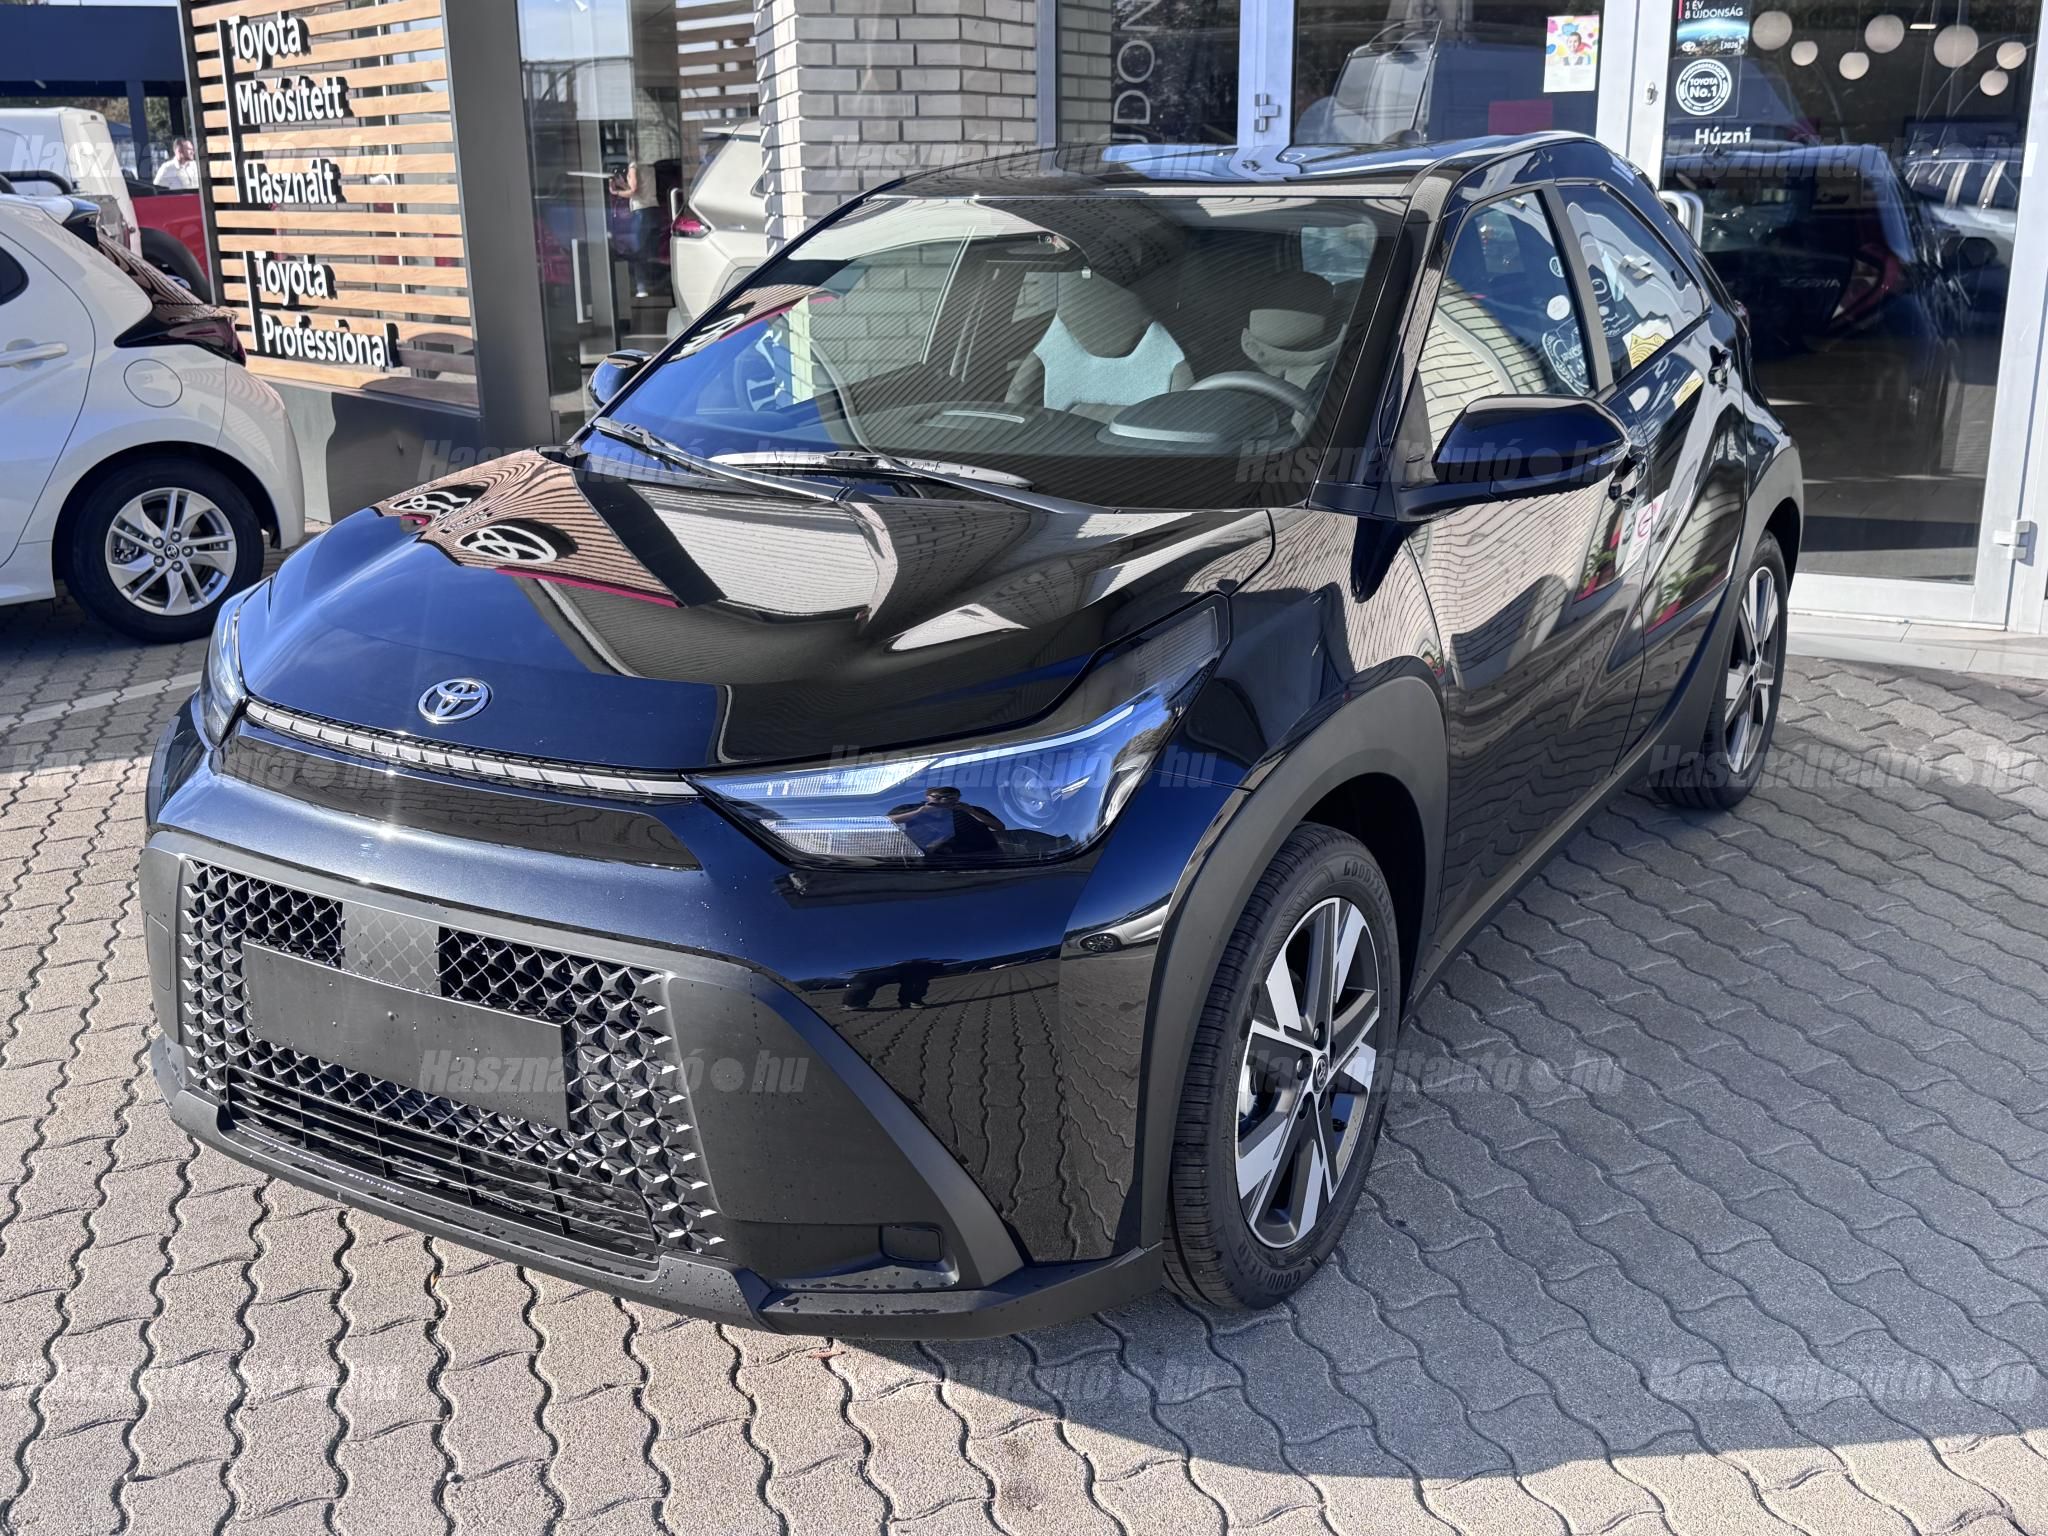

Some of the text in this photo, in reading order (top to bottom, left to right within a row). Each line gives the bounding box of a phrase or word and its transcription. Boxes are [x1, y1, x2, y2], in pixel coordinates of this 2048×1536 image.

[228, 11, 301, 71] Toyota
[235, 75, 344, 126] Minősített
[1689, 77, 1718, 86] TOYOTA
[1689, 85, 1718, 98] No.1
[1694, 126, 1751, 145] Húzni
[244, 157, 337, 204] Használt
[254, 250, 329, 306] Toyota
[260, 312, 394, 369] Professional
